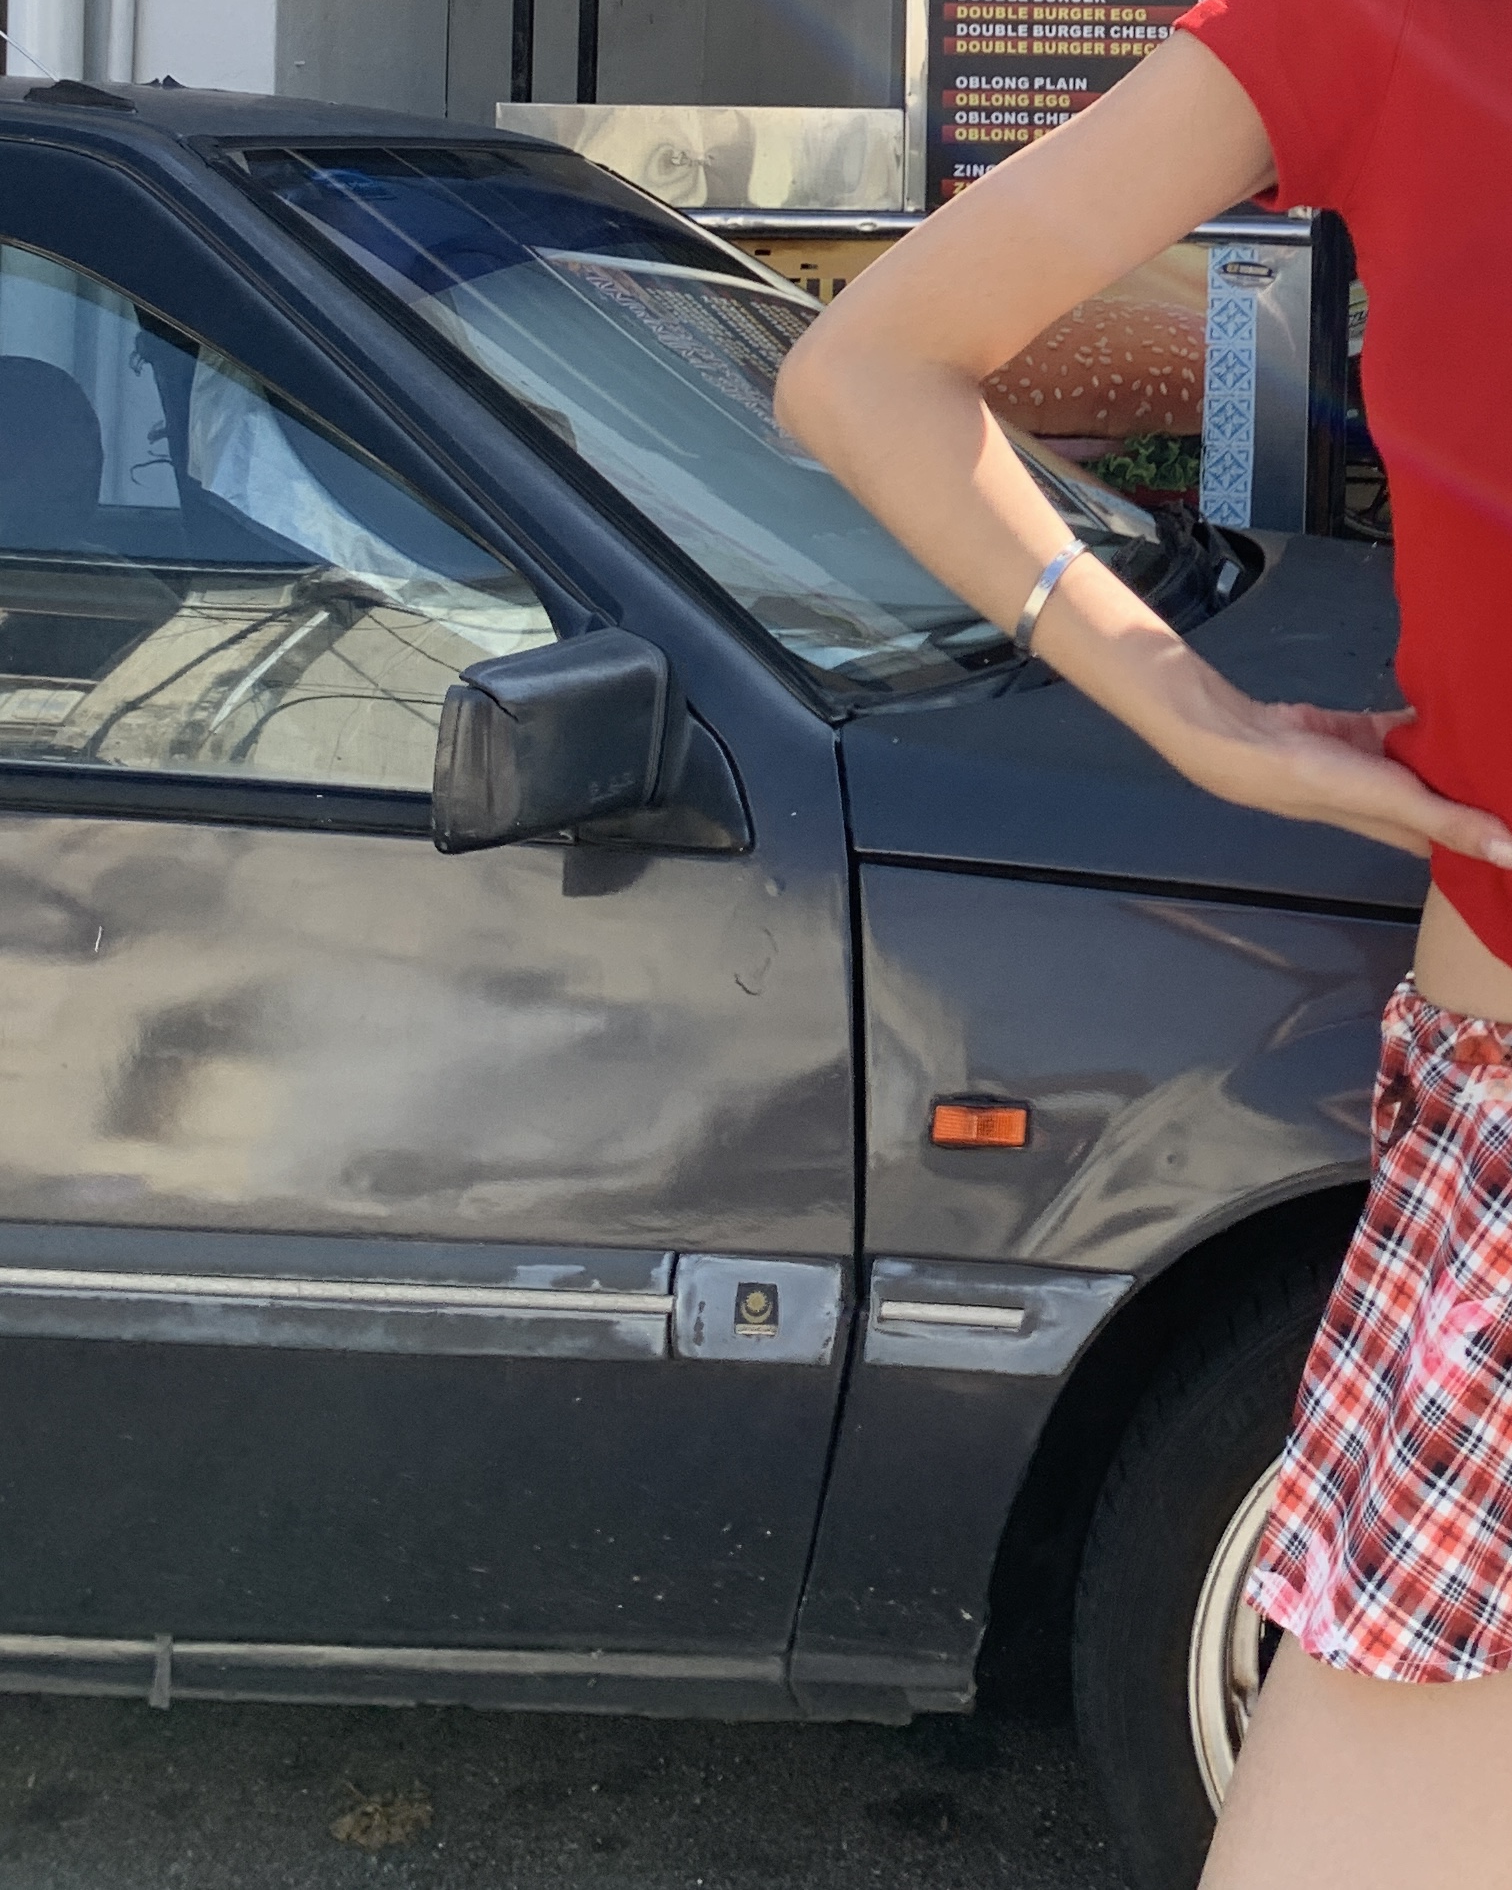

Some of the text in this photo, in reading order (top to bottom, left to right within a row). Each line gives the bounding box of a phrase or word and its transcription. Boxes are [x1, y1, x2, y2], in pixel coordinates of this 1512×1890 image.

[956, 5, 1147, 22] DOUBLE BURGER EGG
[956, 23, 1029, 38] DOUBLE
[1032, 24, 1106, 39] BURGER
[956, 39, 1160, 56] DOUBLE BURGER SPEC
[955, 75, 1088, 91] OBLONG PLAIN
[955, 93, 1071, 108] OBLONG EGG
[954, 111, 1079, 125] OBLONG CHE
[954, 127, 1029, 142] OBLONG
